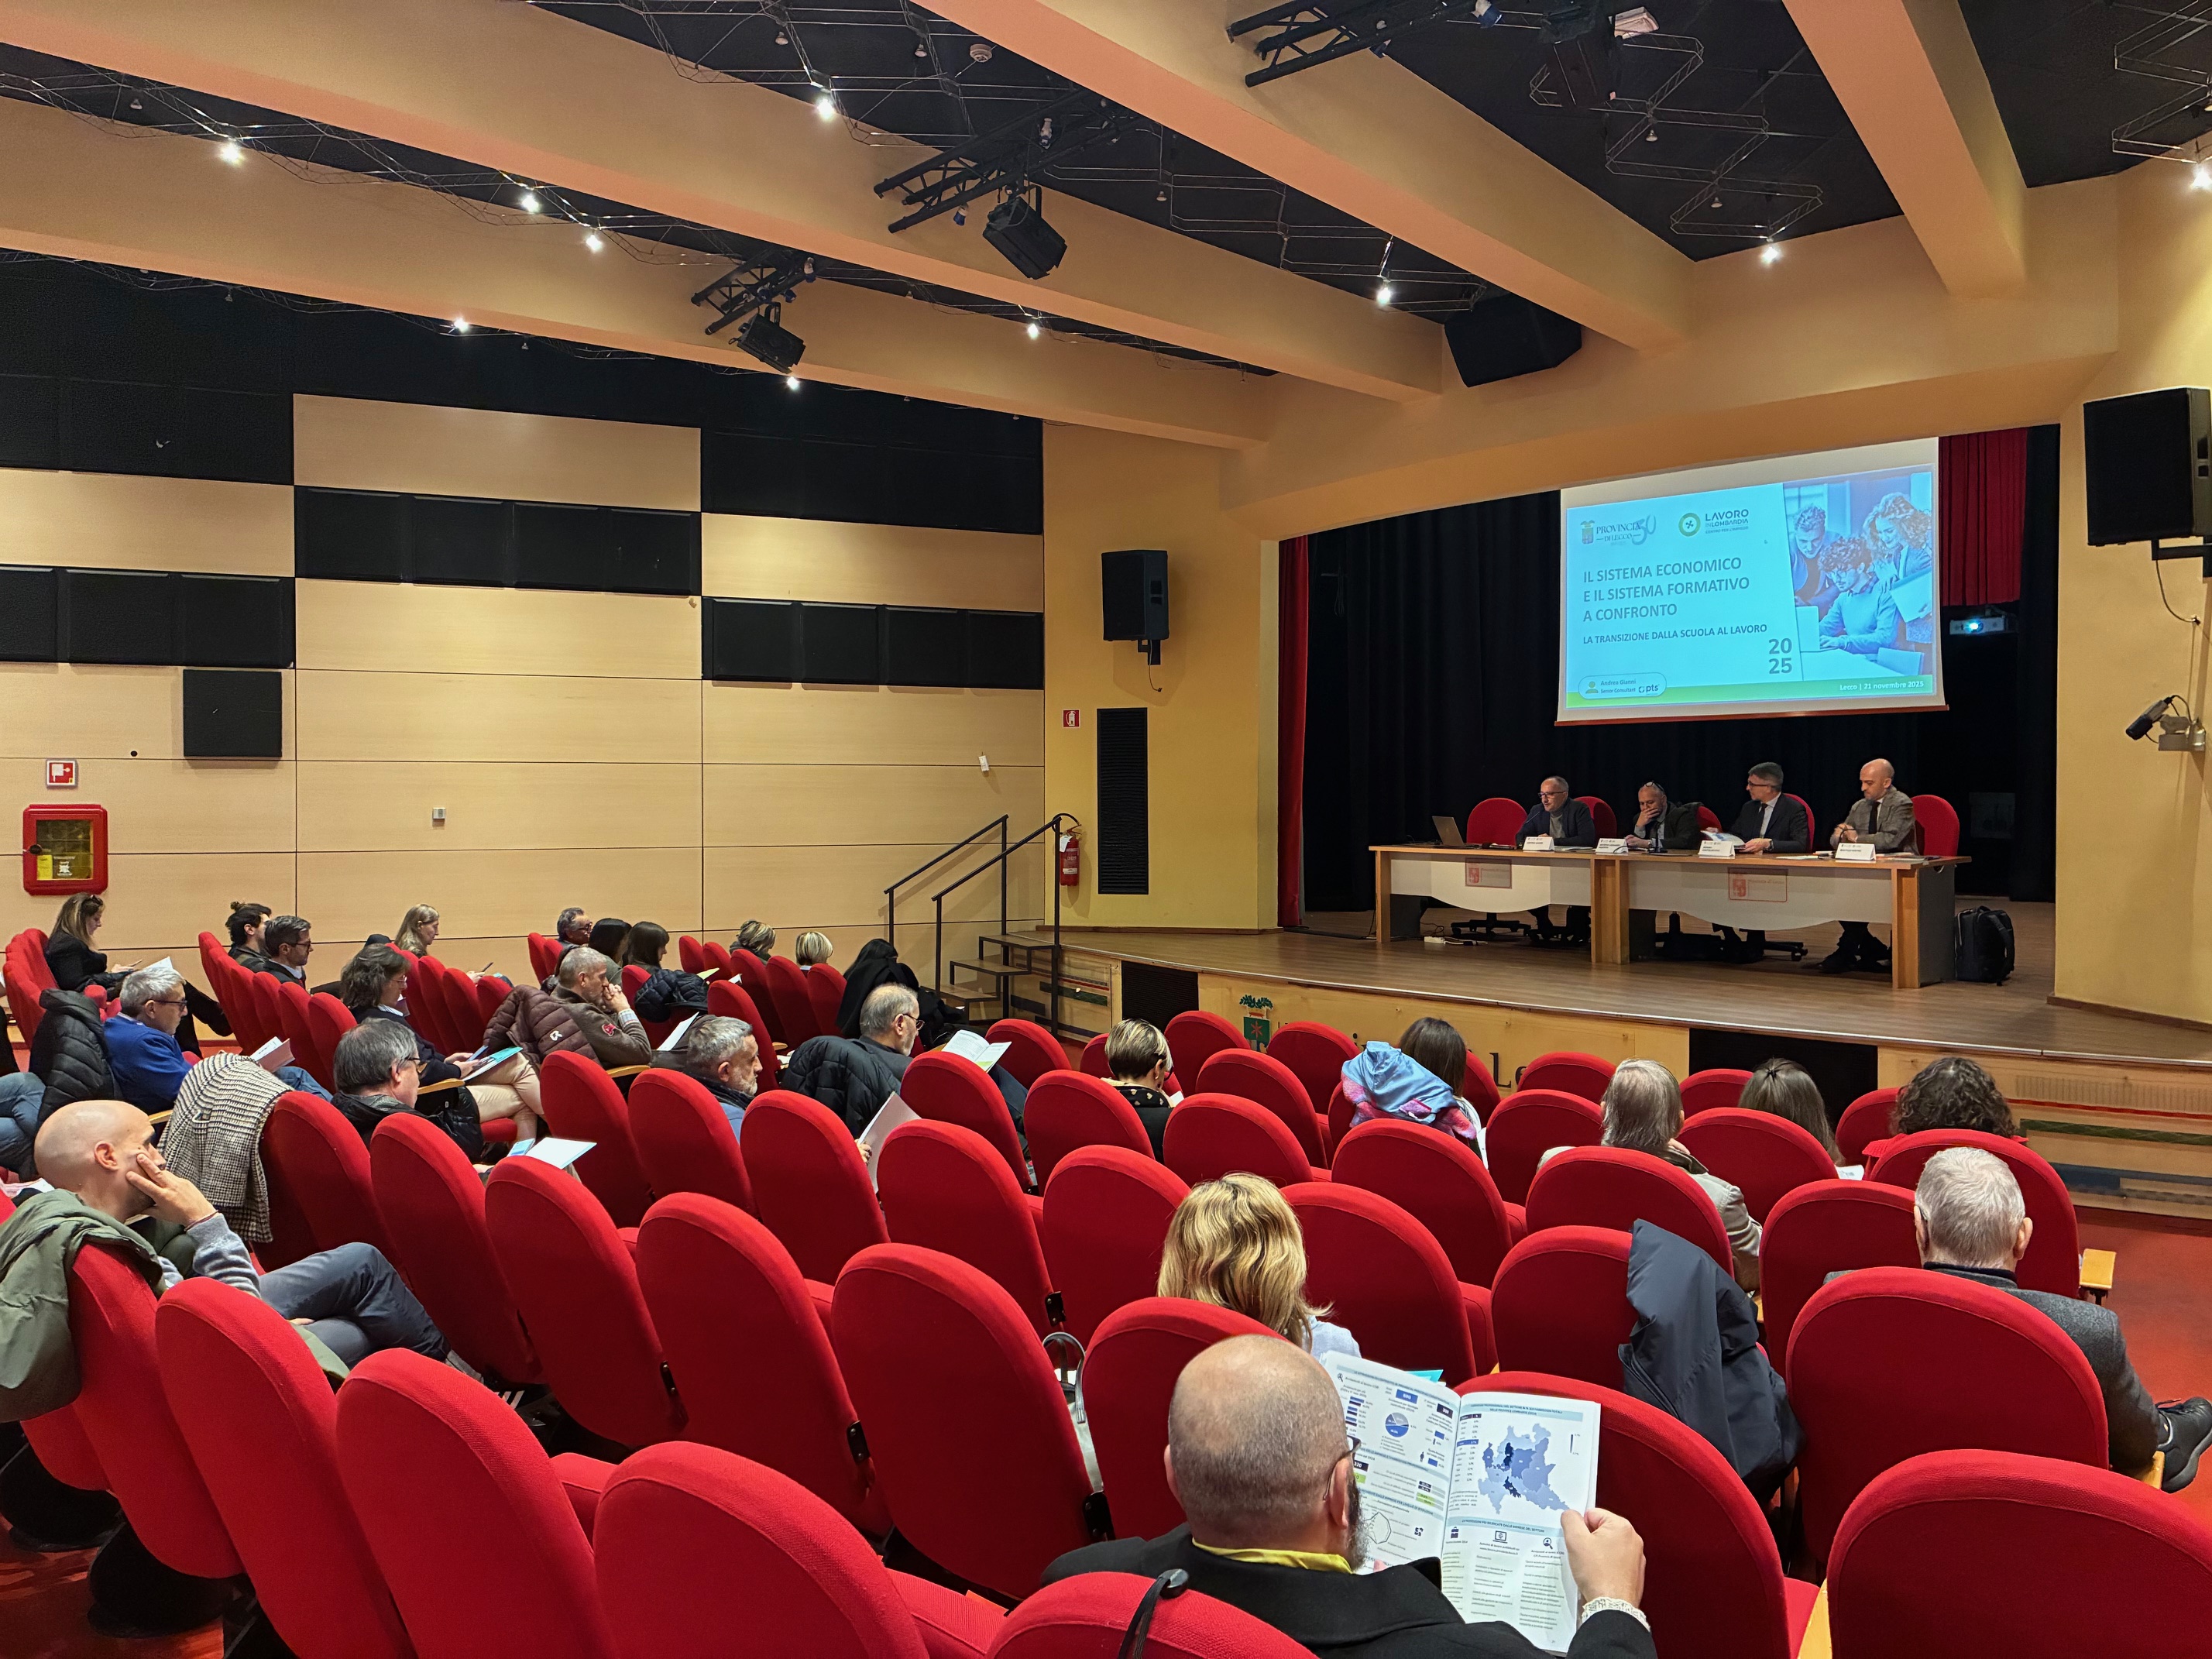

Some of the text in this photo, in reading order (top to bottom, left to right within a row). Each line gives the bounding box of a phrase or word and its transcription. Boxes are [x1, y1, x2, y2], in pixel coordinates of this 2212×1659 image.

[1705, 509, 1749, 521] LAVORO
[1596, 522, 1641, 534] PROVINCIA
[1584, 557, 1742, 582] IL SISTEMA ECONOMICO
[1584, 577, 1750, 602] E IL SISTEMA FORMATIVO
[1583, 603, 1678, 622] A CONFRONTO
[1595, 632, 1650, 643] TRANSIZIONE
[1652, 630, 1678, 640] DALLA
[1681, 627, 1715, 637] SCUOLA
[1717, 626, 1728, 635] AL
[1730, 623, 1767, 634] LAVORO
[1768, 637, 1792, 654] 20
[1768, 657, 1792, 675] 25
[1646, 684, 1659, 692] pts
[1873, 681, 1907, 689] novembre
